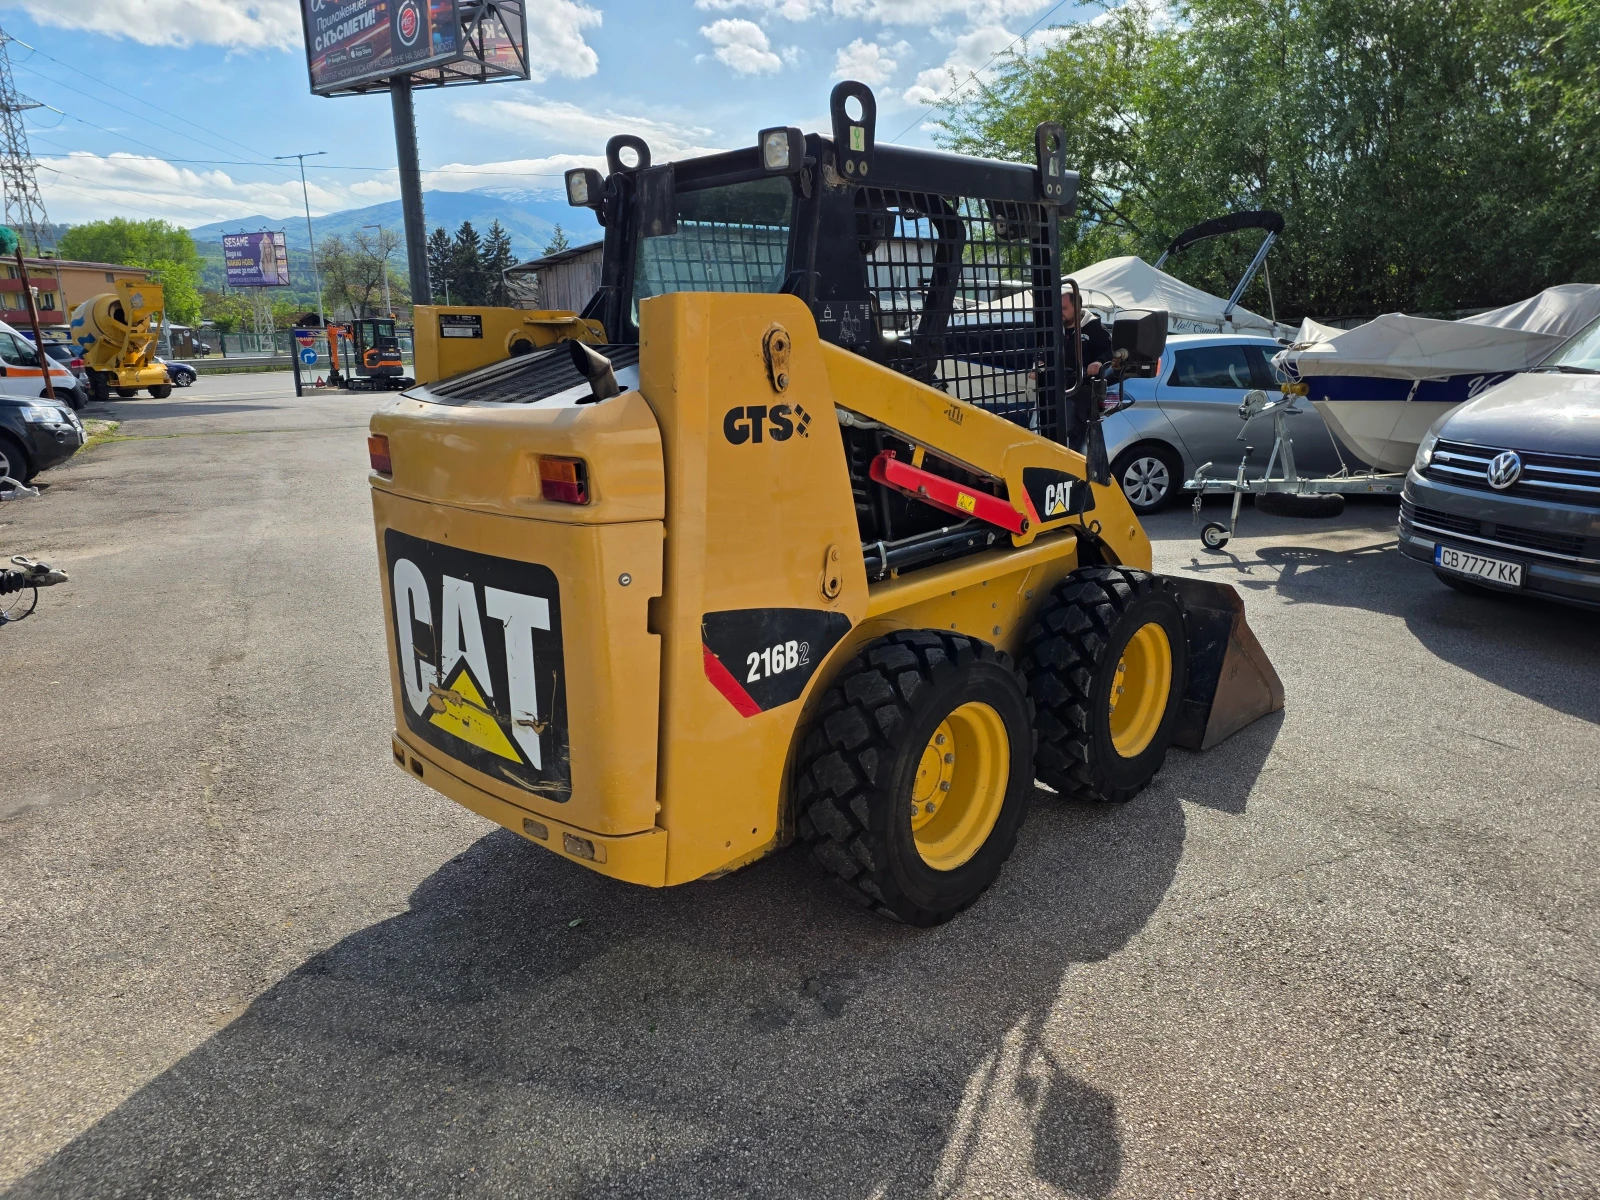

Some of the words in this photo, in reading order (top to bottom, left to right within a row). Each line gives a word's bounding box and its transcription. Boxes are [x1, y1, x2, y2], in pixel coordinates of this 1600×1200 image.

[323, 8, 376, 48] КЪСМЕТИ!
[224, 236, 249, 247] SESAME
[723, 404, 794, 445] GTS
[1045, 480, 1073, 516] CAT
[1442, 550, 1459, 568] CB
[1461, 554, 1497, 577] 7777
[1498, 563, 1519, 584] KK
[393, 558, 551, 771] CAT
